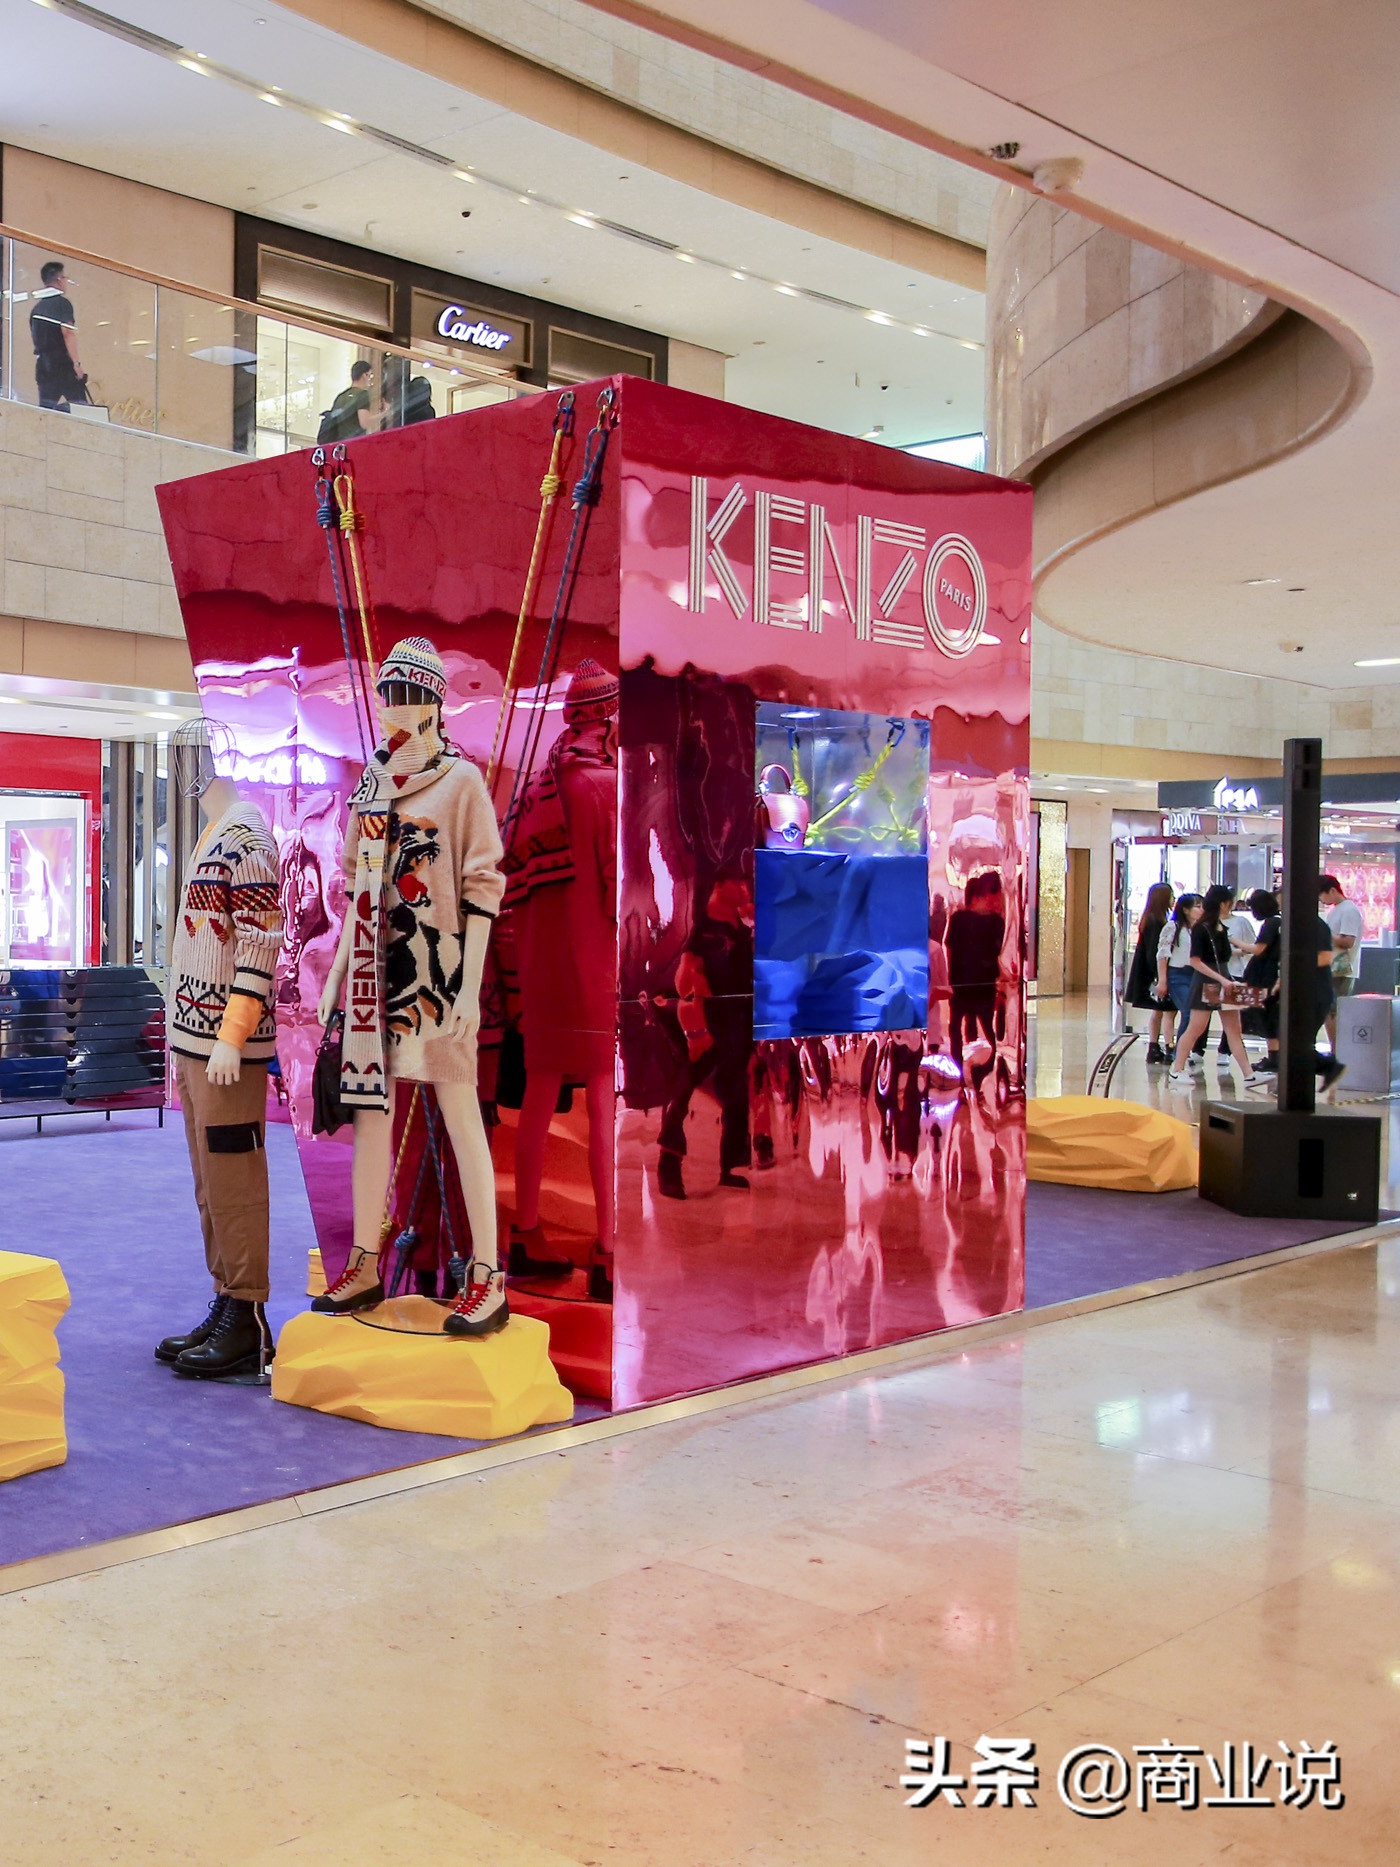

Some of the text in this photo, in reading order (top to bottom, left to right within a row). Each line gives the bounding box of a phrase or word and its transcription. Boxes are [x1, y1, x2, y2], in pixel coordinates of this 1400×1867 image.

[437, 305, 511, 350] Cartier
[688, 475, 988, 660] KENZO
[938, 578, 972, 612] PARIS
[407, 667, 447, 700] KENZ
